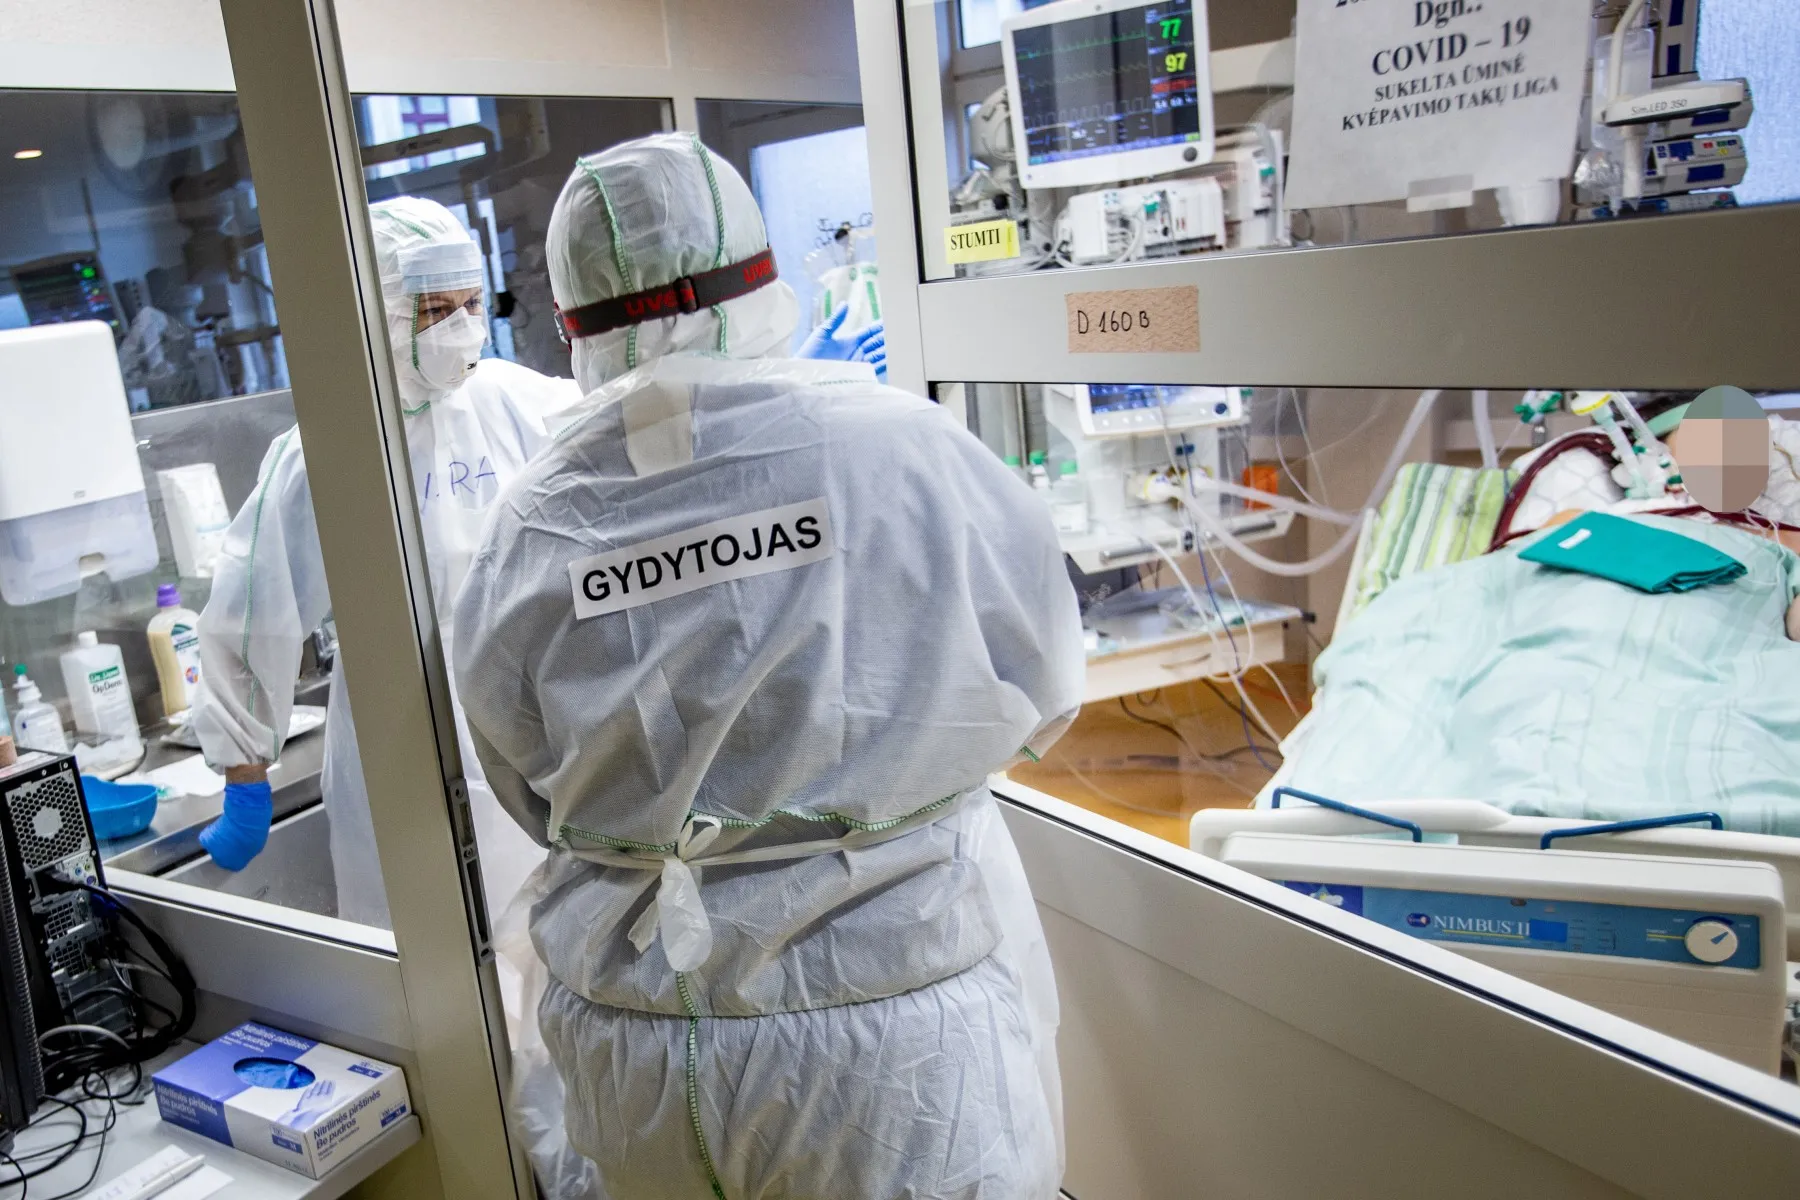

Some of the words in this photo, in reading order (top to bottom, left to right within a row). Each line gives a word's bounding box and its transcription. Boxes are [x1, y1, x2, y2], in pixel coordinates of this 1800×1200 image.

[1159, 18, 1182, 39] 77
[1372, 33, 1468, 76] COVID
[1501, 15, 1531, 49] 19
[1165, 52, 1188, 72] 97
[1374, 72, 1457, 102] SUKELTA
[1342, 98, 1452, 131] KVĖPAVIMO
[1512, 76, 1559, 99] LIGA
[950, 228, 1001, 251] STUMTI
[1099, 310, 1133, 334] 160
[582, 515, 822, 602] GYDYTOJAS
[1433, 915, 1512, 934] NIMBUS
[329, 1117, 357, 1143] pudros
